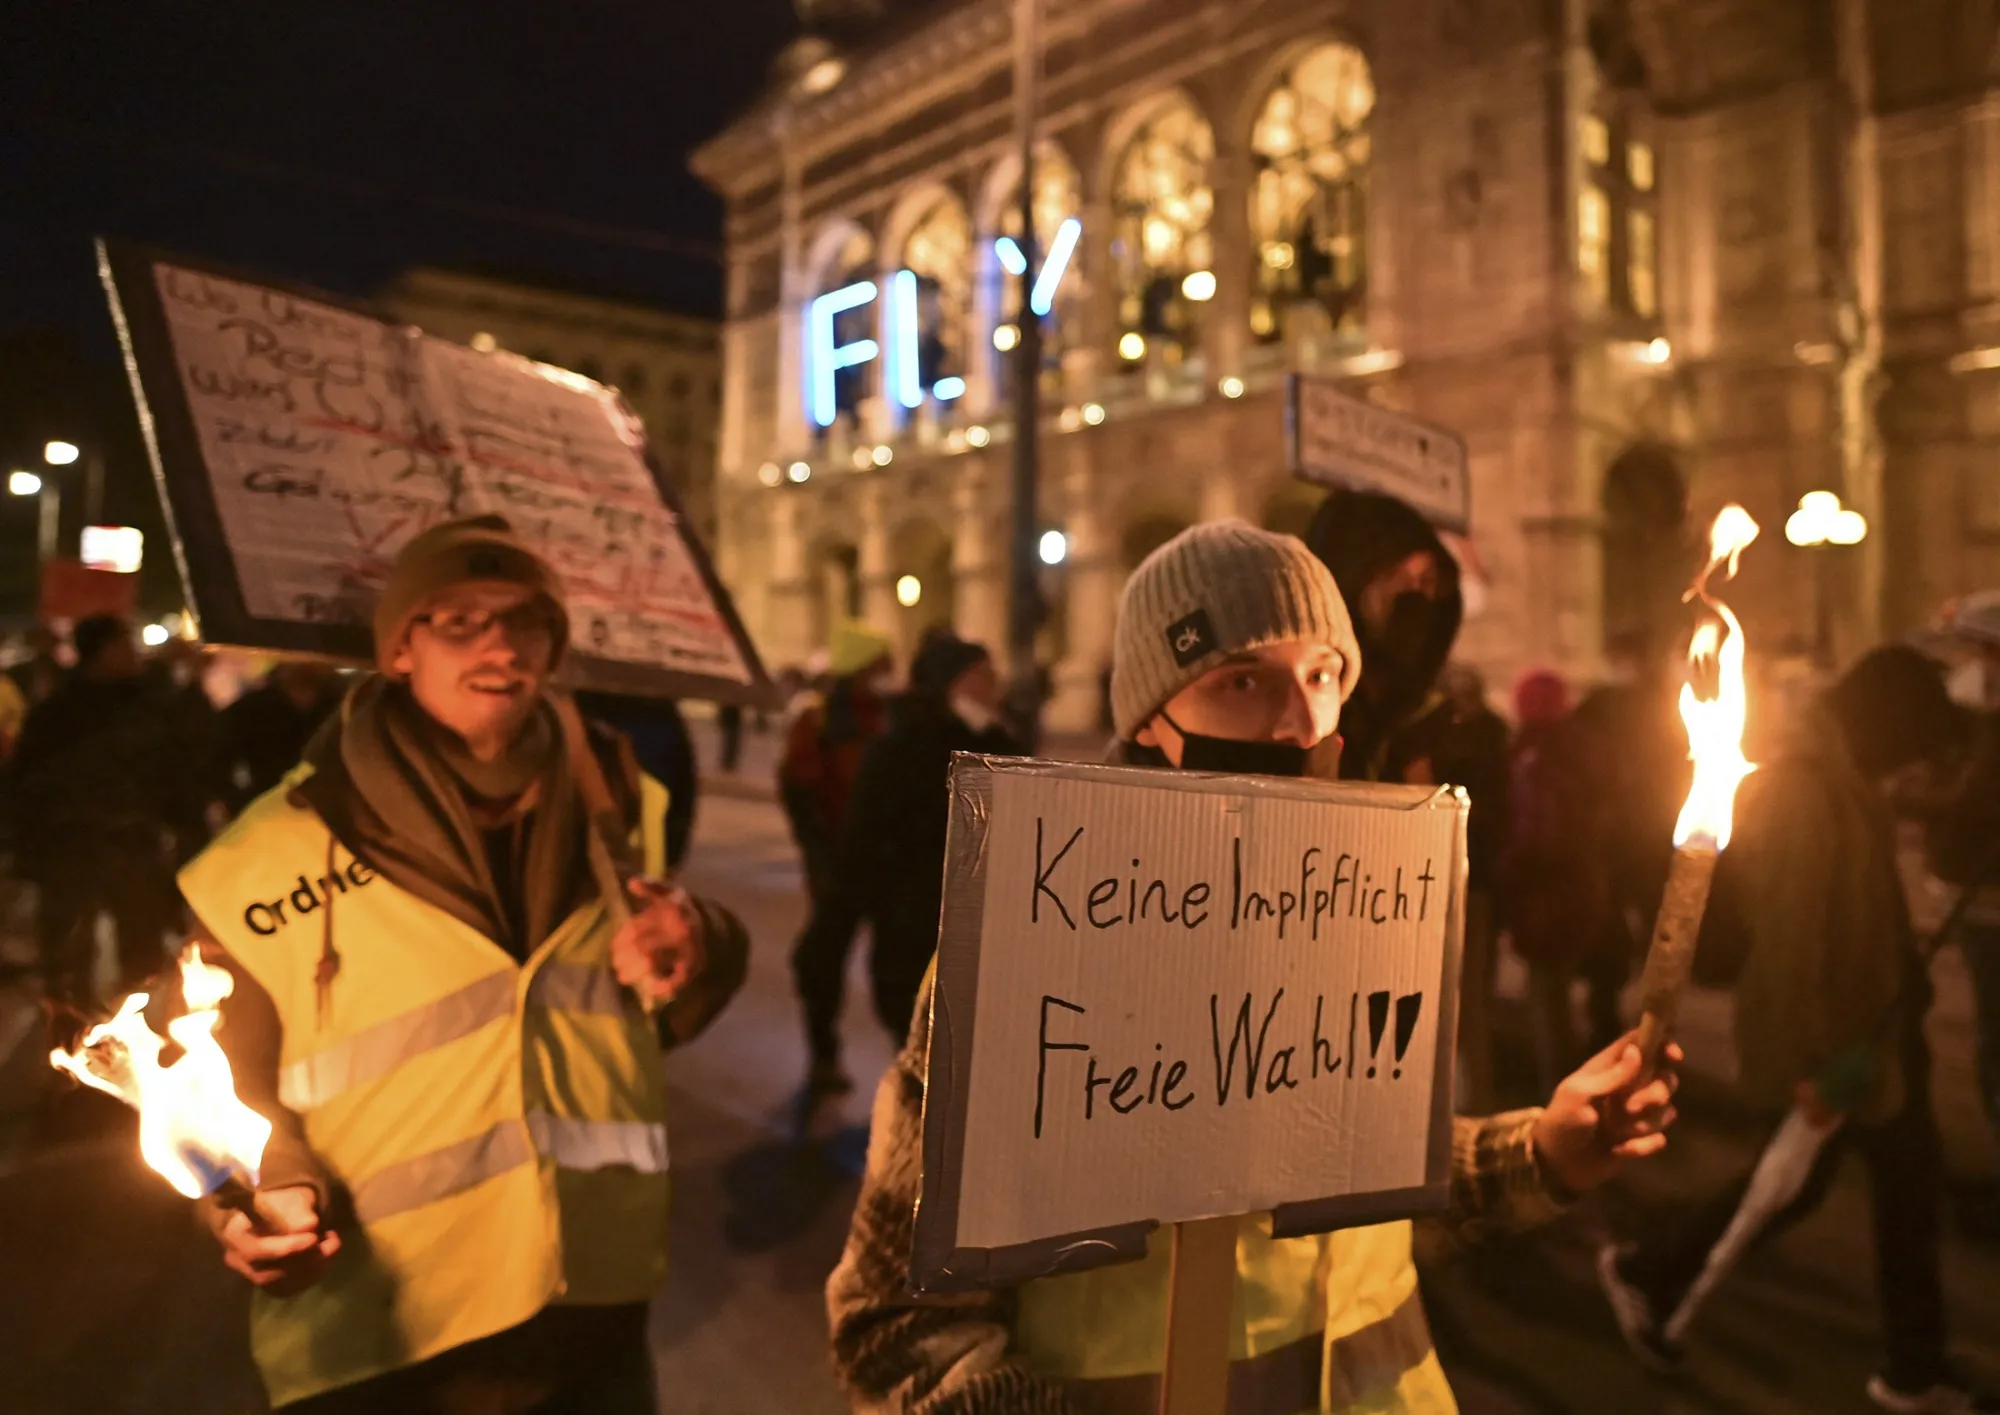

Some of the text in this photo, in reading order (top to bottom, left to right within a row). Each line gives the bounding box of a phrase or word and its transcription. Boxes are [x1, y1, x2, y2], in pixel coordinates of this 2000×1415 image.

[1031, 816, 1436, 941] Keine Impfpflicht
[1033, 987, 1423, 1139] Freie Wahl!!
